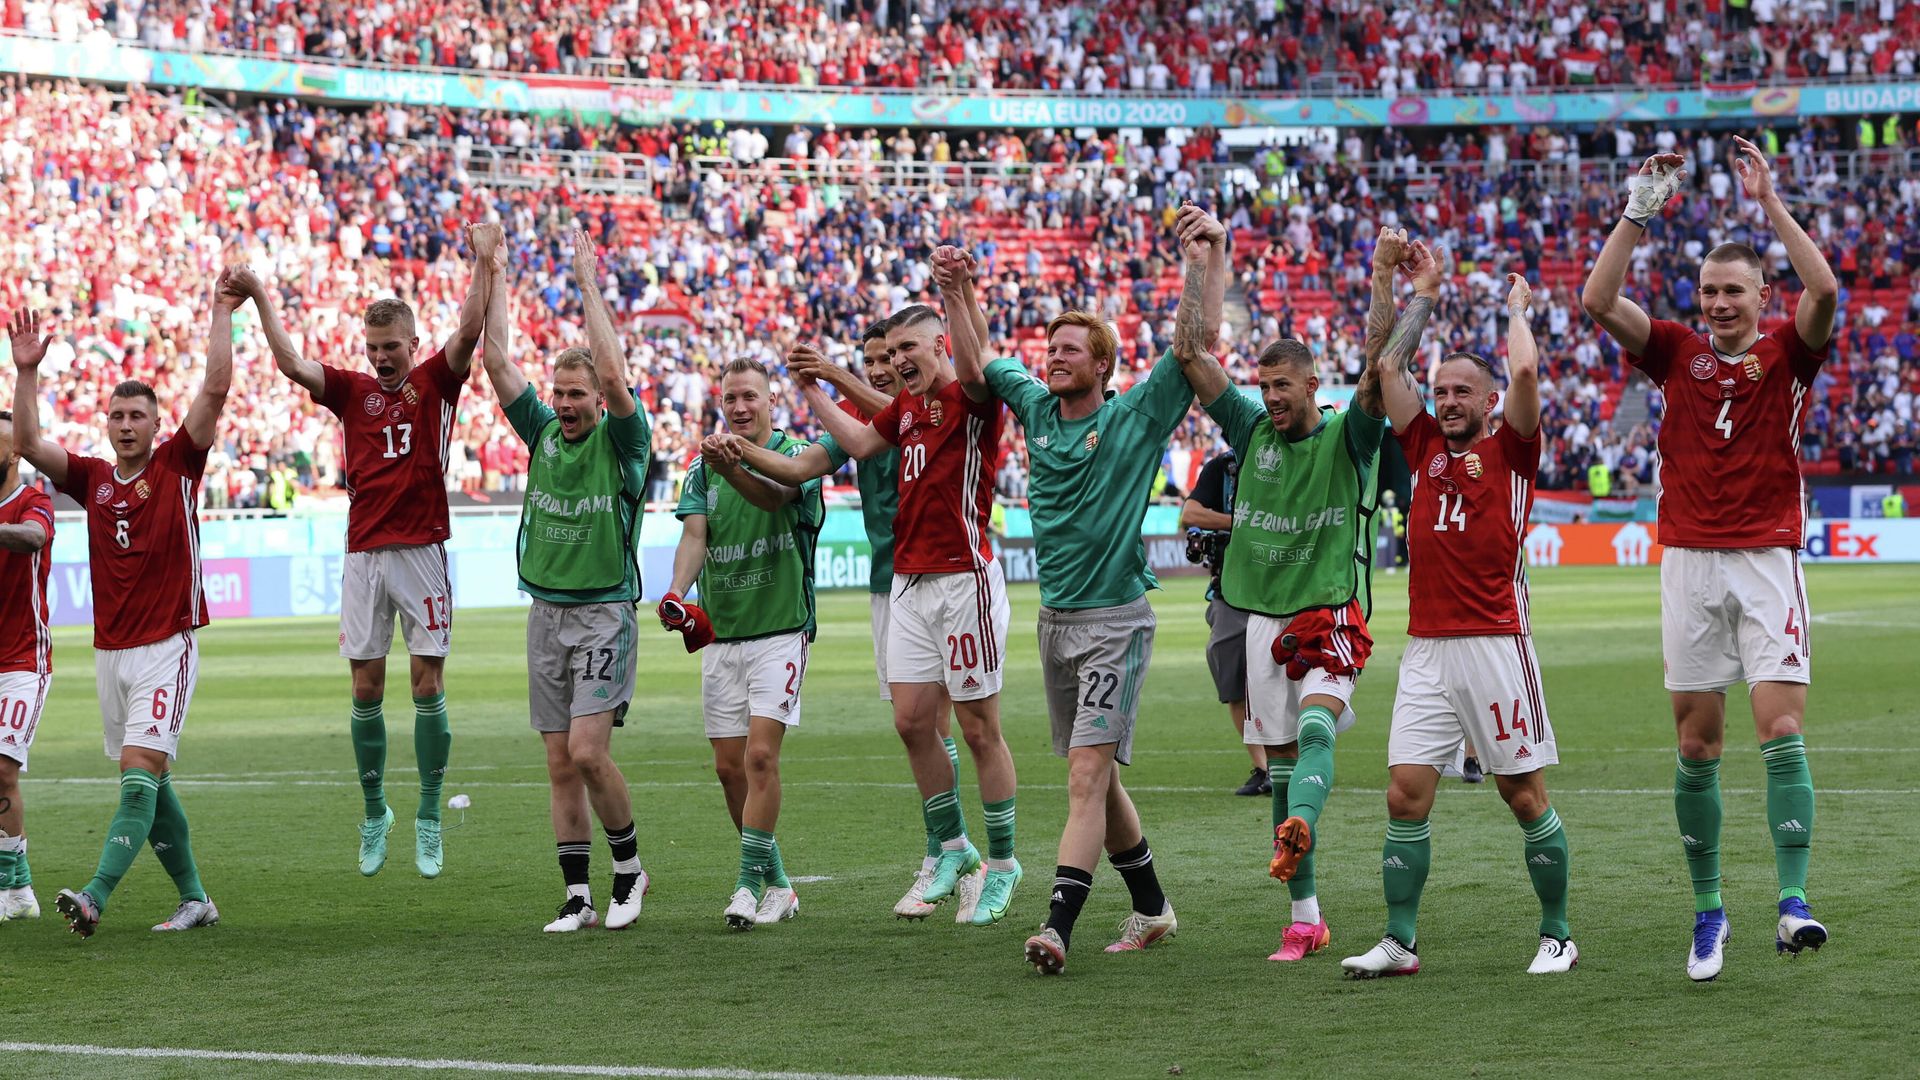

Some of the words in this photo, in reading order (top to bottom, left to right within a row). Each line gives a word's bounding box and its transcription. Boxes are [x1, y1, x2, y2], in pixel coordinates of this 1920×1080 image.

[345, 71, 446, 102] BUDAPEST
[990, 102, 1055, 123] UEFA
[1056, 102, 1122, 123] EURO
[1125, 102, 1187, 124] 2020
[1715, 399, 1733, 439] 4
[382, 423, 413, 459] 13
[904, 443, 927, 482] 20
[1433, 493, 1466, 532] 14
[116, 519, 131, 549] 6
[751, 531, 796, 559] GAME
[1269, 548, 1314, 562] RESPEC
[724, 570, 774, 590] RESPECT
[423, 595, 449, 631] 13
[1784, 607, 1800, 646] 4
[582, 648, 614, 681] 12
[947, 633, 978, 671] 20
[785, 661, 797, 695] 2
[1083, 671, 1119, 710] 22
[0, 697, 28, 730] 10
[152, 688, 168, 720] 6
[1489, 698, 1529, 741] 14
